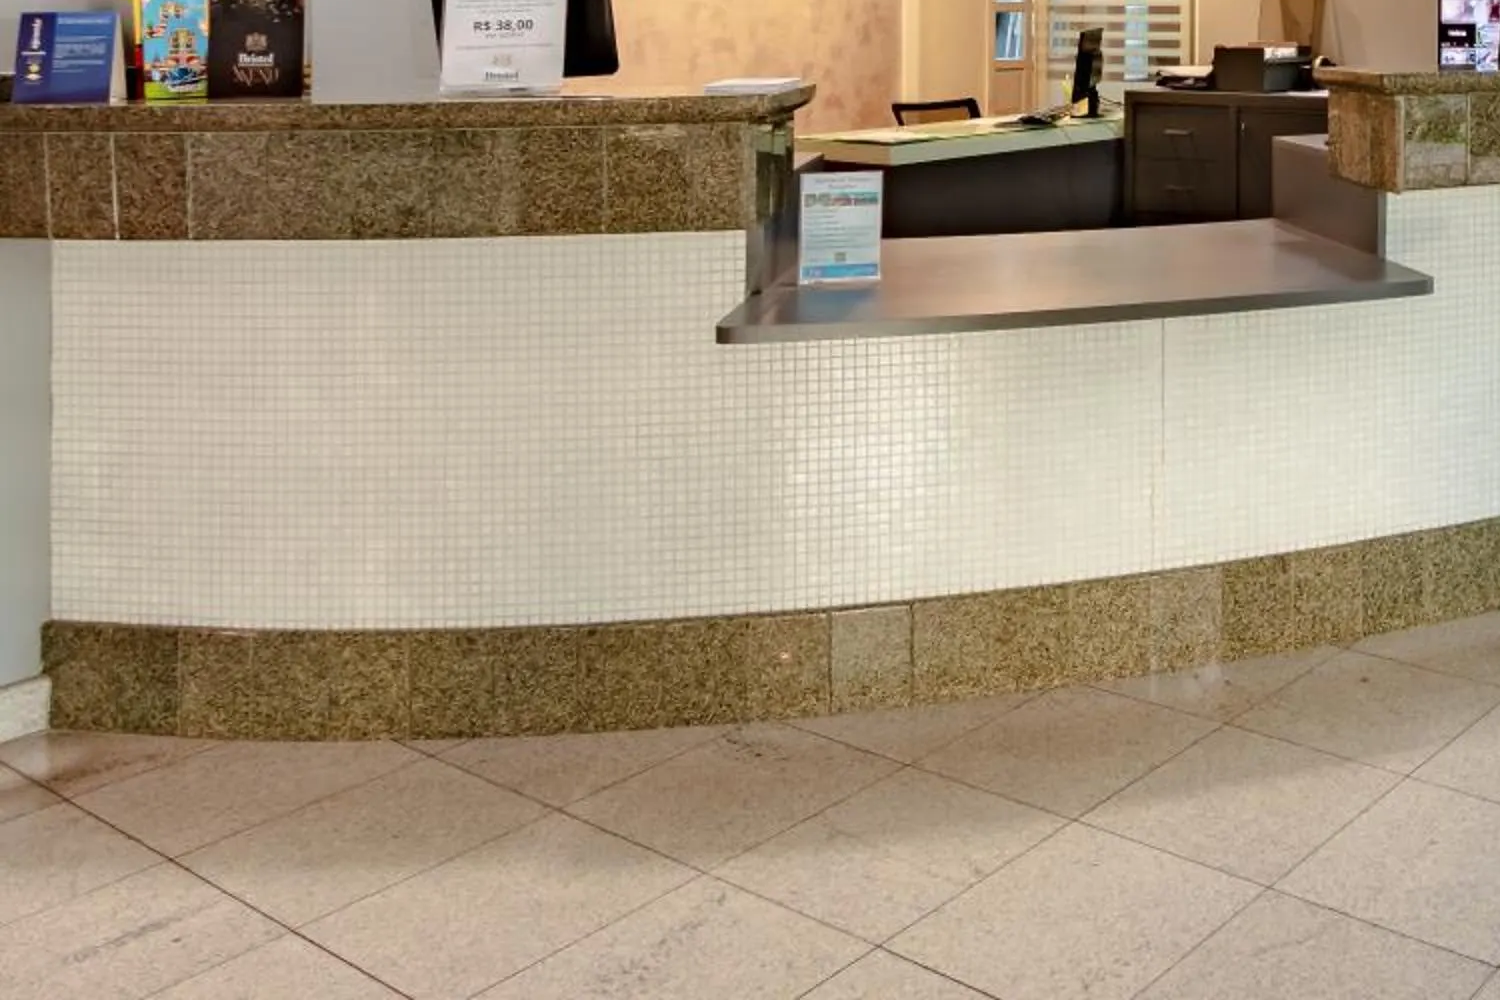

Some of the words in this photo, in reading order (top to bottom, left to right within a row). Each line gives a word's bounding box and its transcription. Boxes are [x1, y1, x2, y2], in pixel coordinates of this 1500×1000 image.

[473, 20, 491, 32] R$
[495, 19, 534, 32] 38,00
[231, 64, 280, 87] MNU
